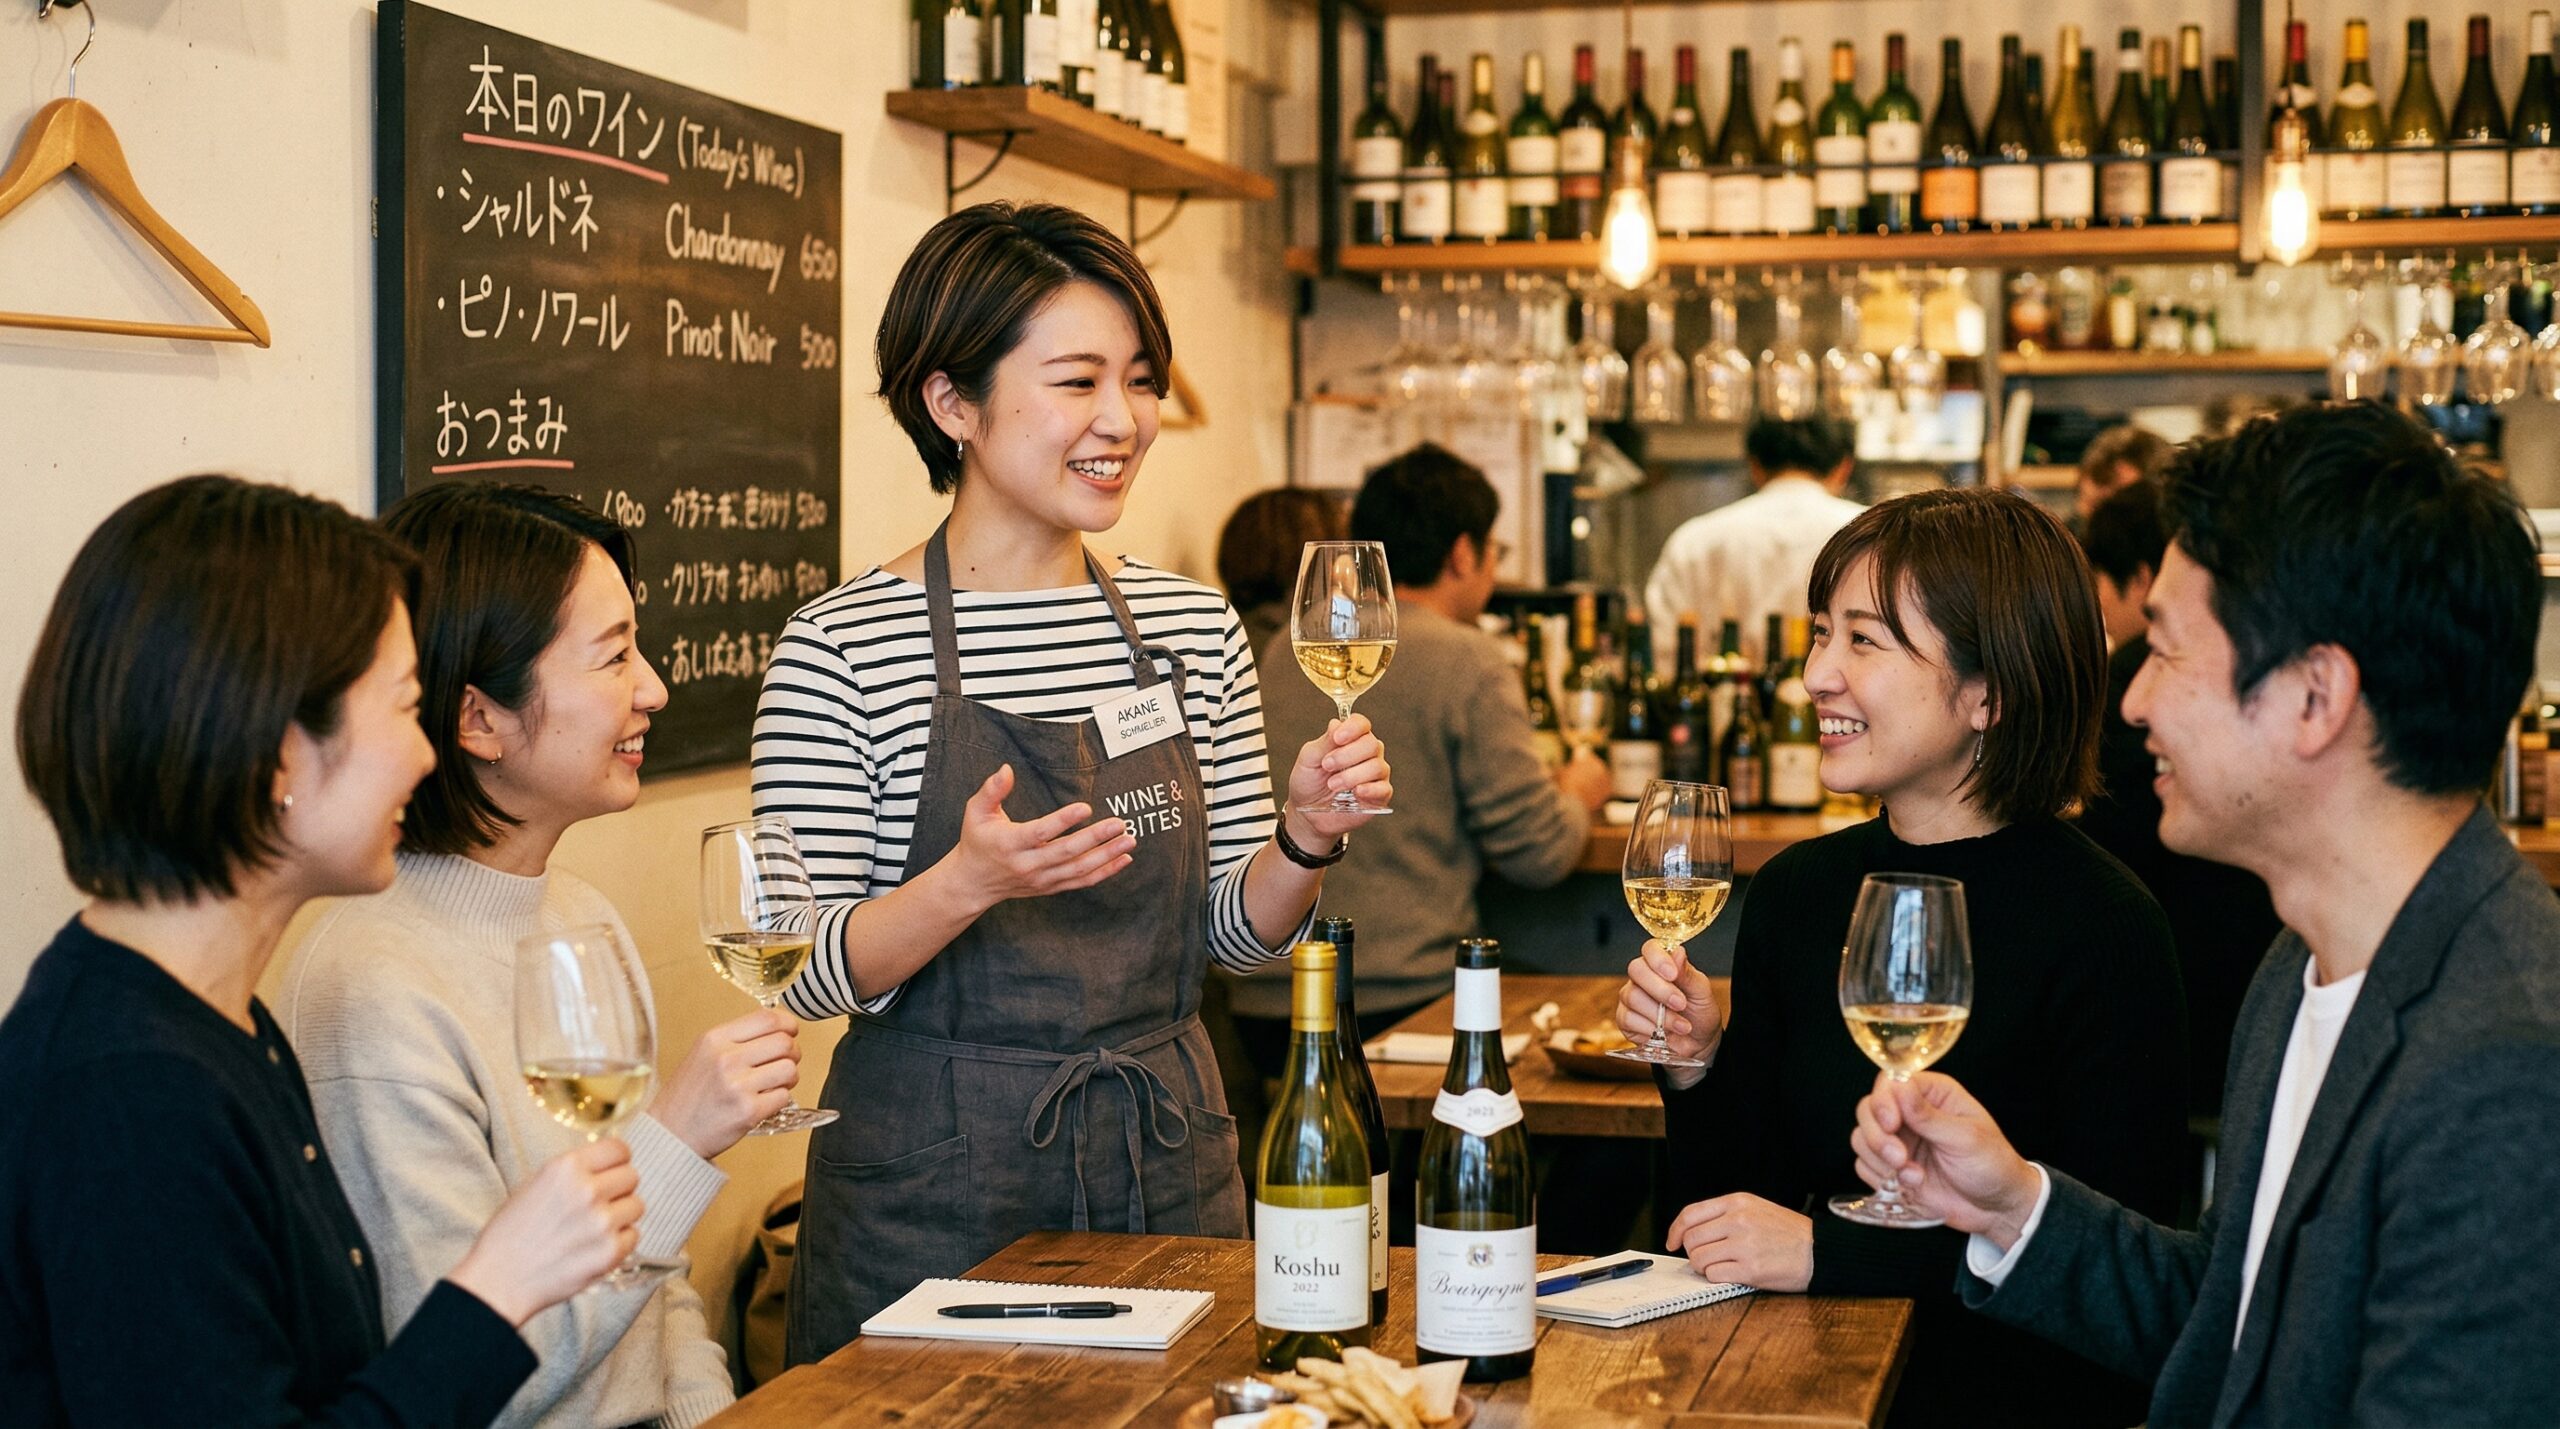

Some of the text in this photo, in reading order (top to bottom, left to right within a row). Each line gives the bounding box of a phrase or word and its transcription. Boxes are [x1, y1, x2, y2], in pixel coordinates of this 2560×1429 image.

[466, 45, 805, 200] 本日のワイン (Today's Wine)
[665, 202, 786, 294] Chardonnay
[800, 232, 838, 281] 650
[667, 298, 723, 361] Pinot
[731, 309, 777, 364] Noir
[800, 323, 837, 369] 500
[436, 388, 568, 457] おつまみ
[1117, 697, 1160, 725] AKANE
[1105, 779, 1184, 816] WINE &
[1274, 1255, 1341, 1277] Koshu
[1292, 1282, 1320, 1293] 2022
[1428, 1270, 1527, 1306] Bourgogne
